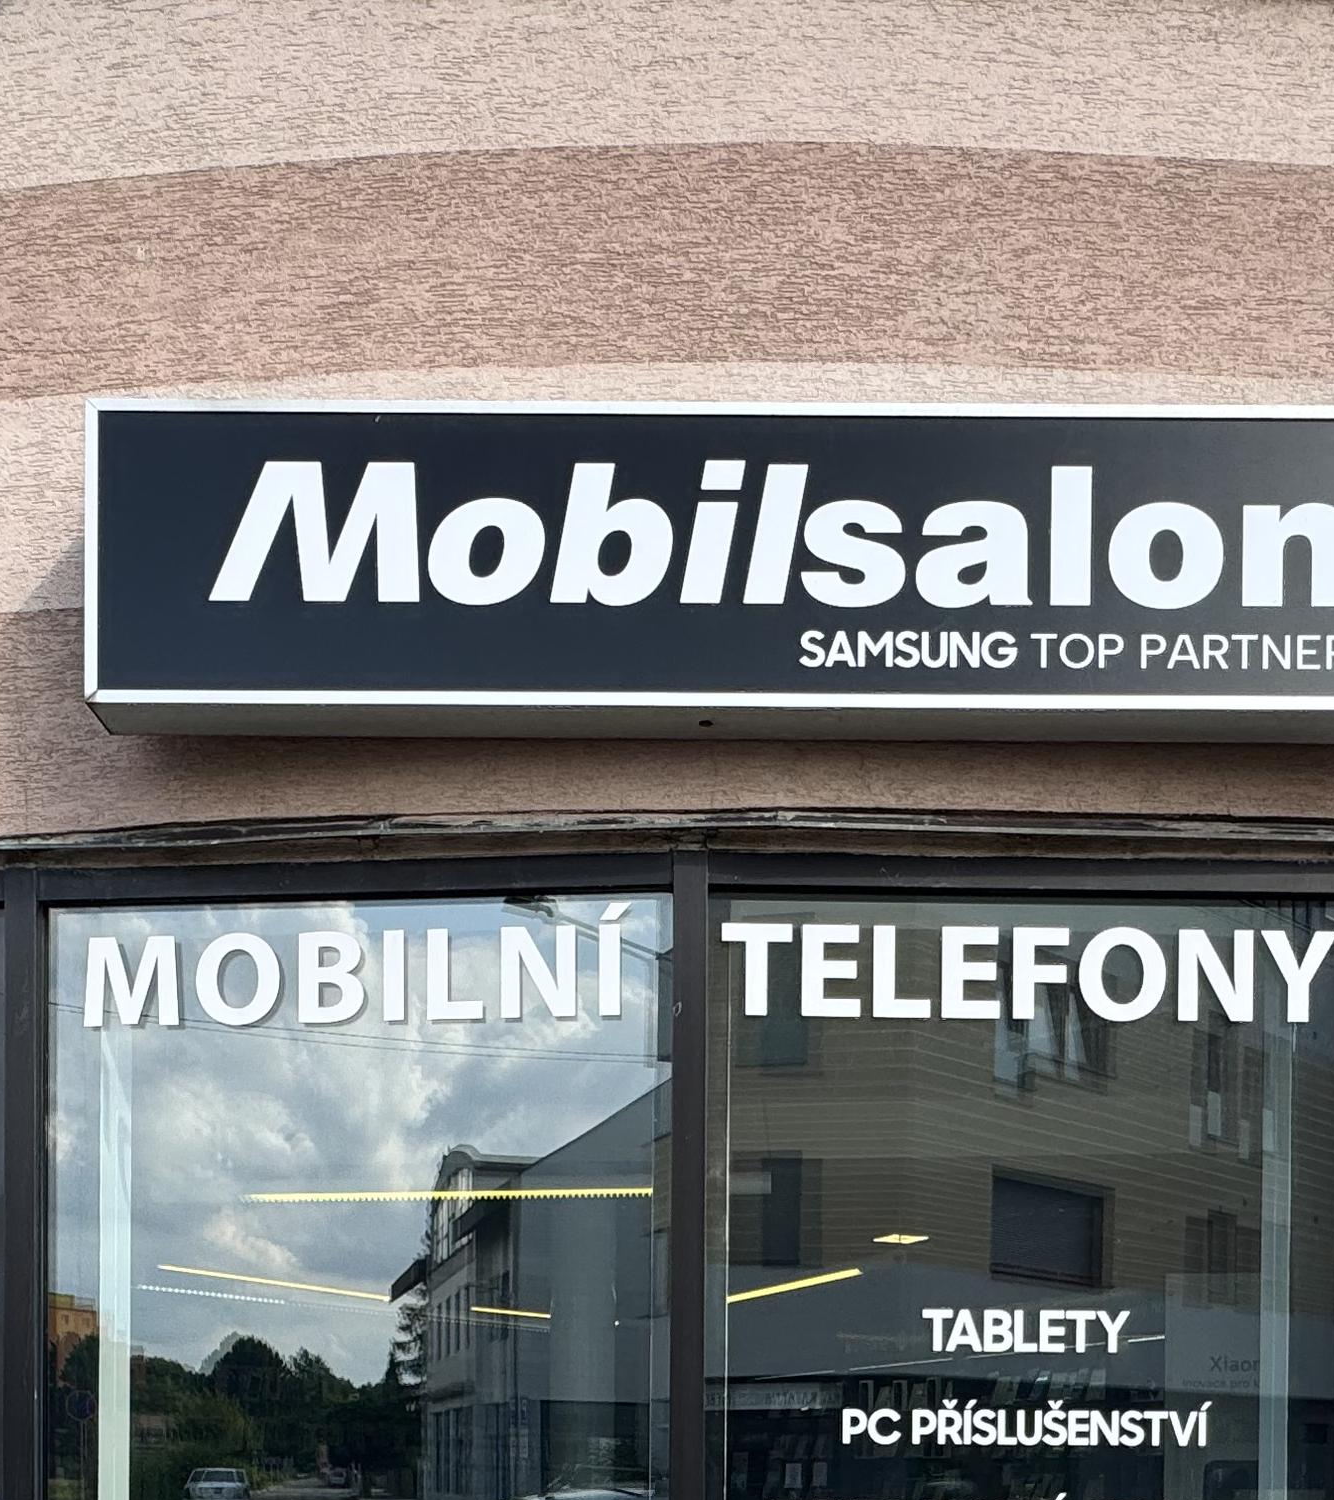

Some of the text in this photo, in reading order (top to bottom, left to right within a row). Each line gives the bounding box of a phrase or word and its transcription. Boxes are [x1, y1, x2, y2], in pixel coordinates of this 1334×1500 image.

[798, 628, 1018, 671] SAMSUNG
[1029, 630, 1127, 672] TOP
[82, 902, 633, 1029] MOBILNÍ
[921, 1308, 1131, 1354] TABLETY
[841, 1399, 1213, 1448] PC PŘÍSLUŠENSTVÍ
